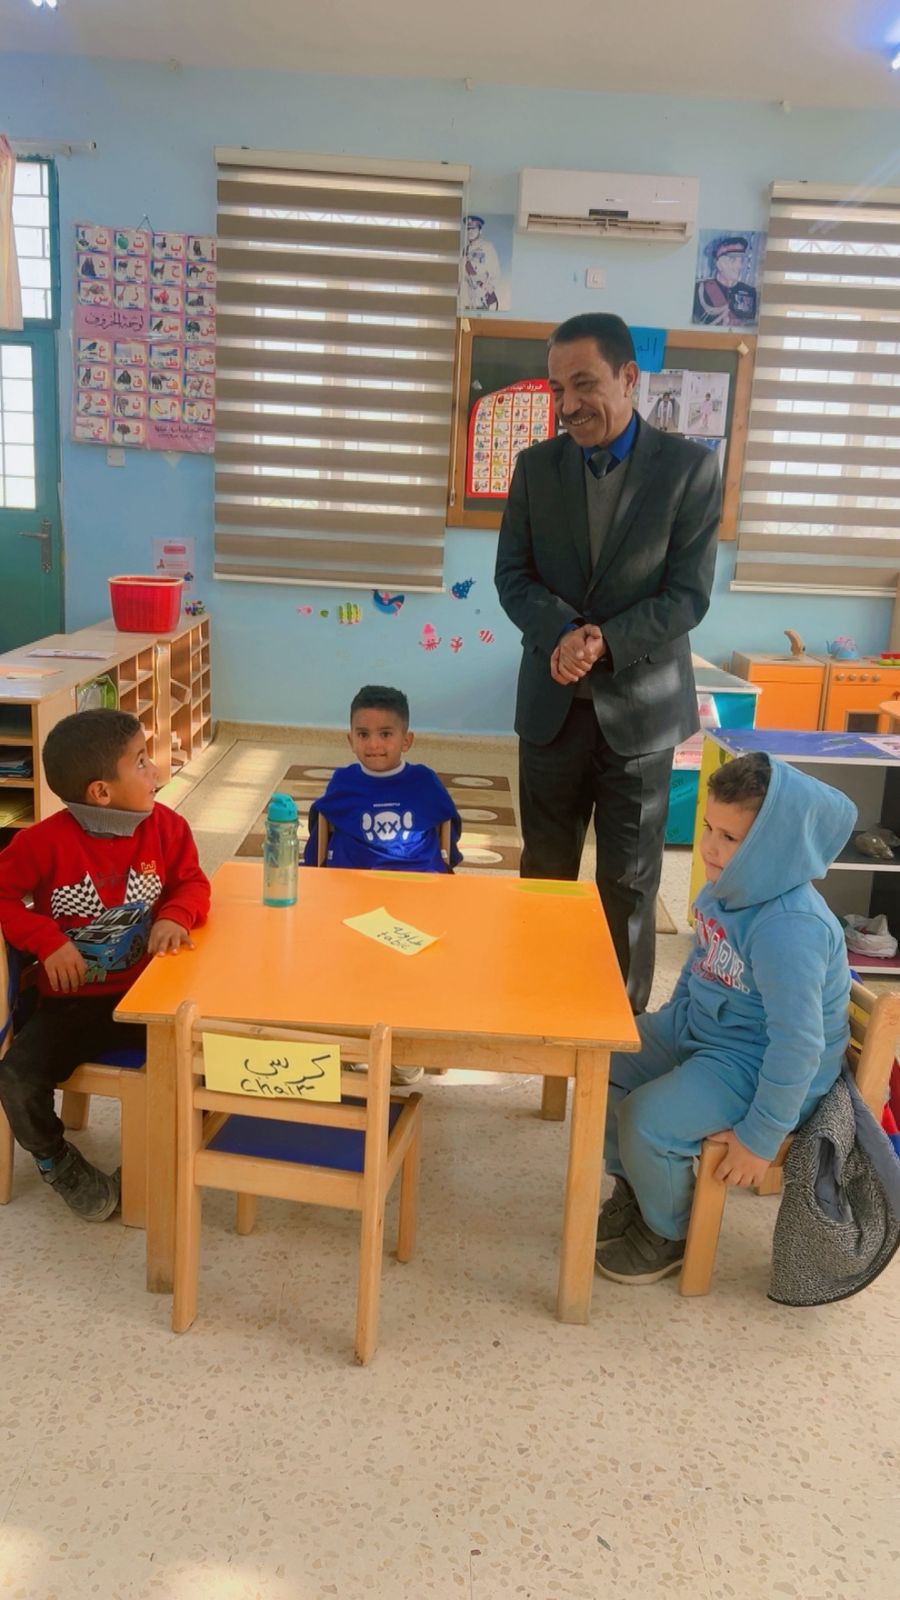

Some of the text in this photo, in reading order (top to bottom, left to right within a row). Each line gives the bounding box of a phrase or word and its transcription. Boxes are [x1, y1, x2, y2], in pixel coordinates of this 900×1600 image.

[133, 237, 144, 248] ت
[171, 244, 181, 256] ب
[99, 260, 106, 268] د
[134, 260, 143, 277] خ
[171, 265, 180, 277] ح
